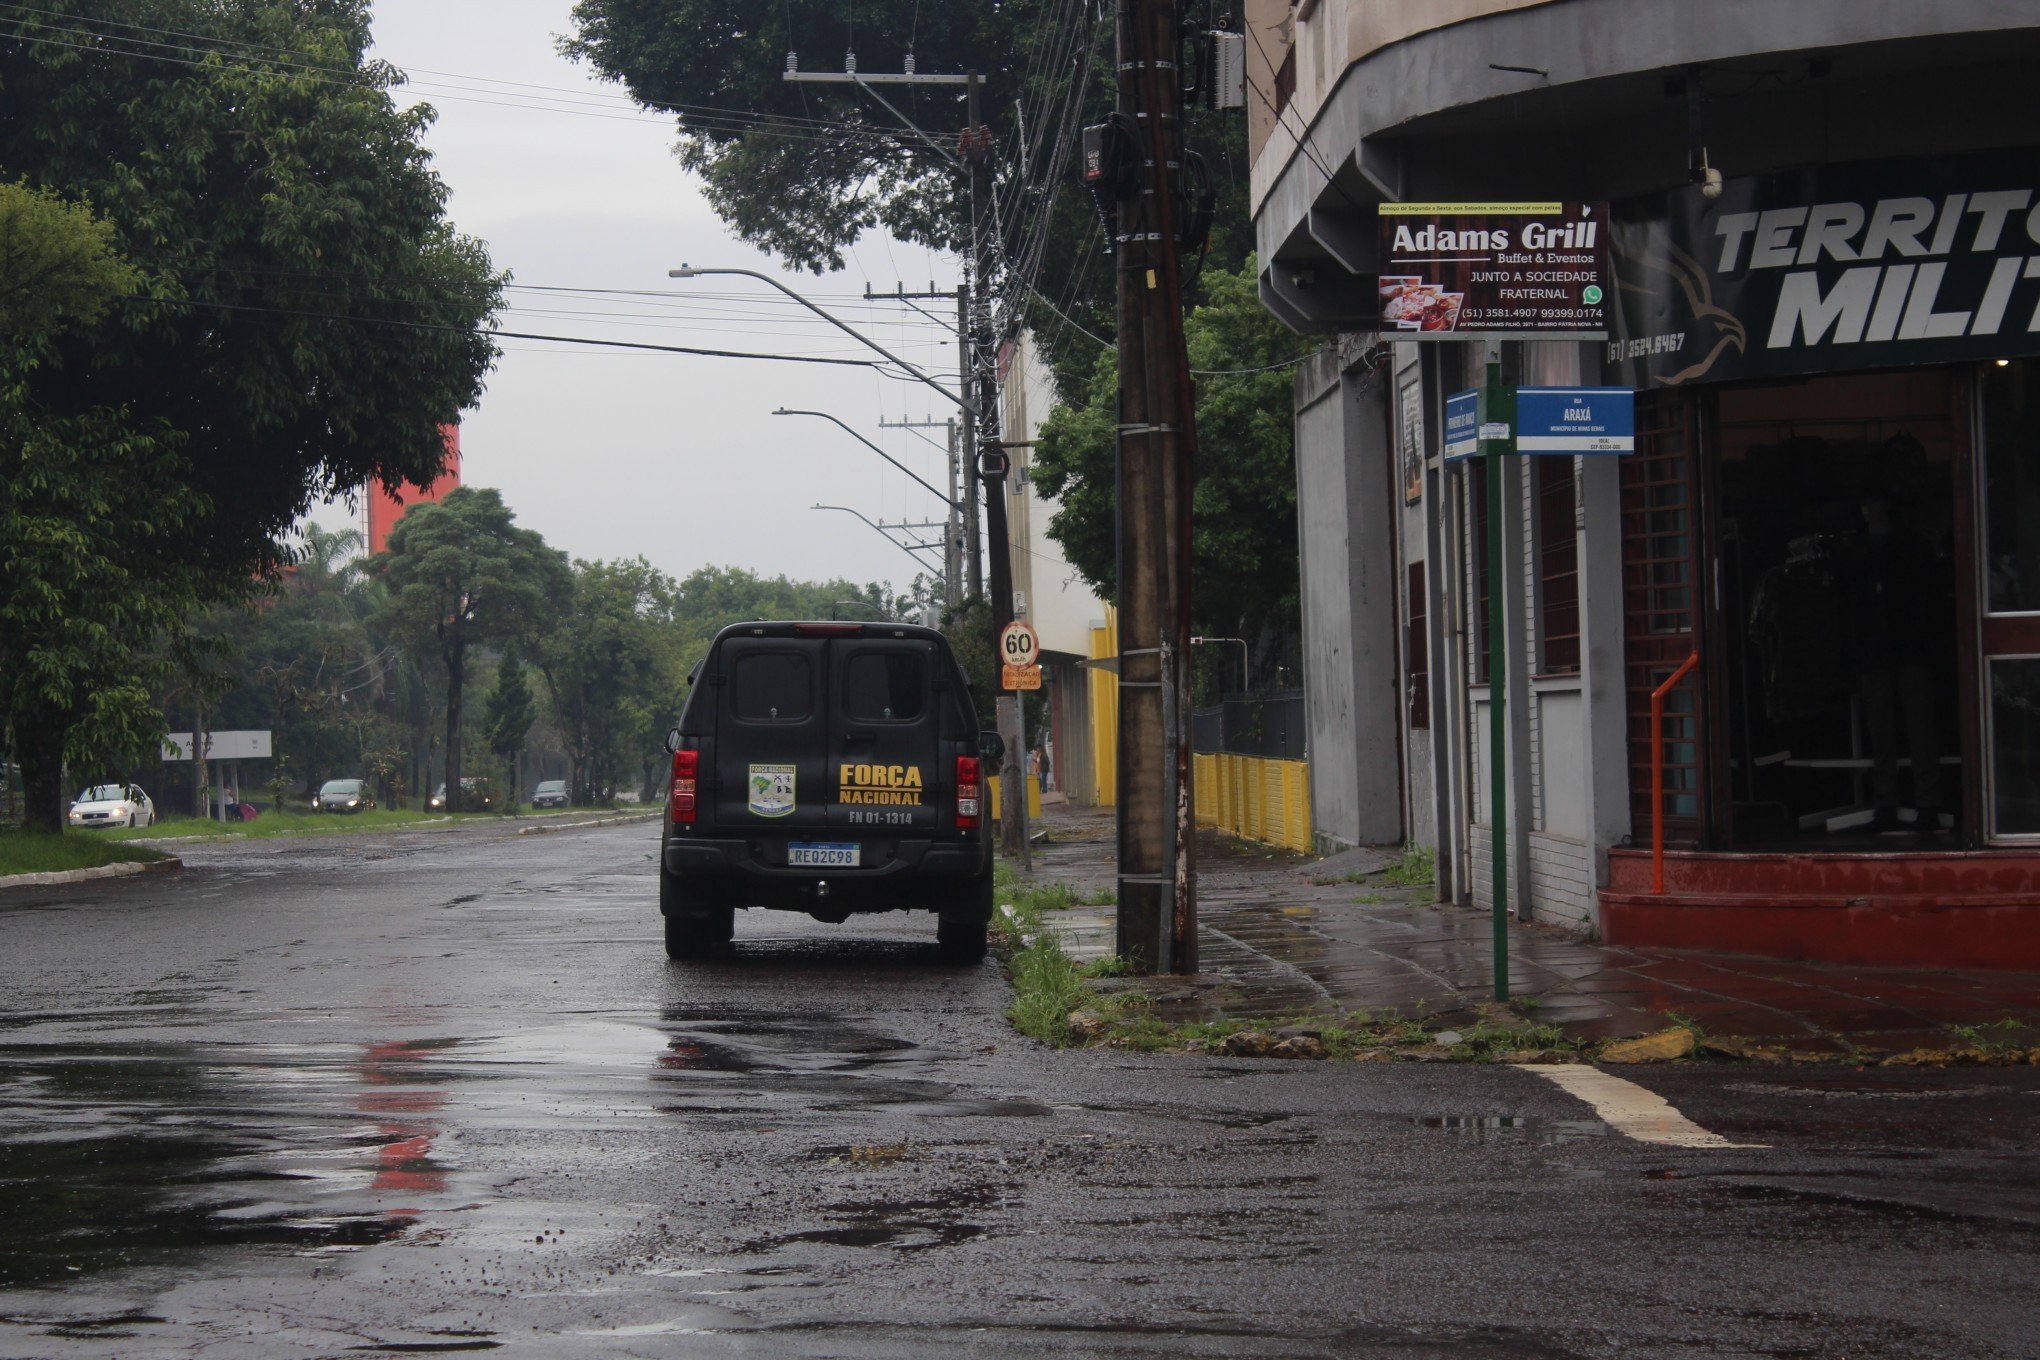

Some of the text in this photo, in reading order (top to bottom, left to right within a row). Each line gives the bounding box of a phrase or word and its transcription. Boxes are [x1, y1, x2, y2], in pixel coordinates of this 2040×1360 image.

[1392, 221, 1597, 252] Adams Grill
[1714, 189, 2040, 273] TERRIT
[1497, 253, 1595, 264] Buffet & Eventos
[1470, 272, 1598, 282] JUNTO A SOCIEDADE
[1500, 289, 1569, 299] FRATERNAL
[1766, 256, 2040, 349] MILI
[1462, 309, 1603, 319] (51) 3581.4907 99399.0174
[1628, 332, 1685, 358] 3524.6467
[1563, 406, 1592, 422] ARAXÁ
[1005, 633, 1032, 654] 60
[840, 764, 923, 789] FORÇA
[839, 790, 922, 806] NACIONAL
[849, 811, 913, 825] FN 01-1314
[795, 850, 852, 864] REQ2C98
